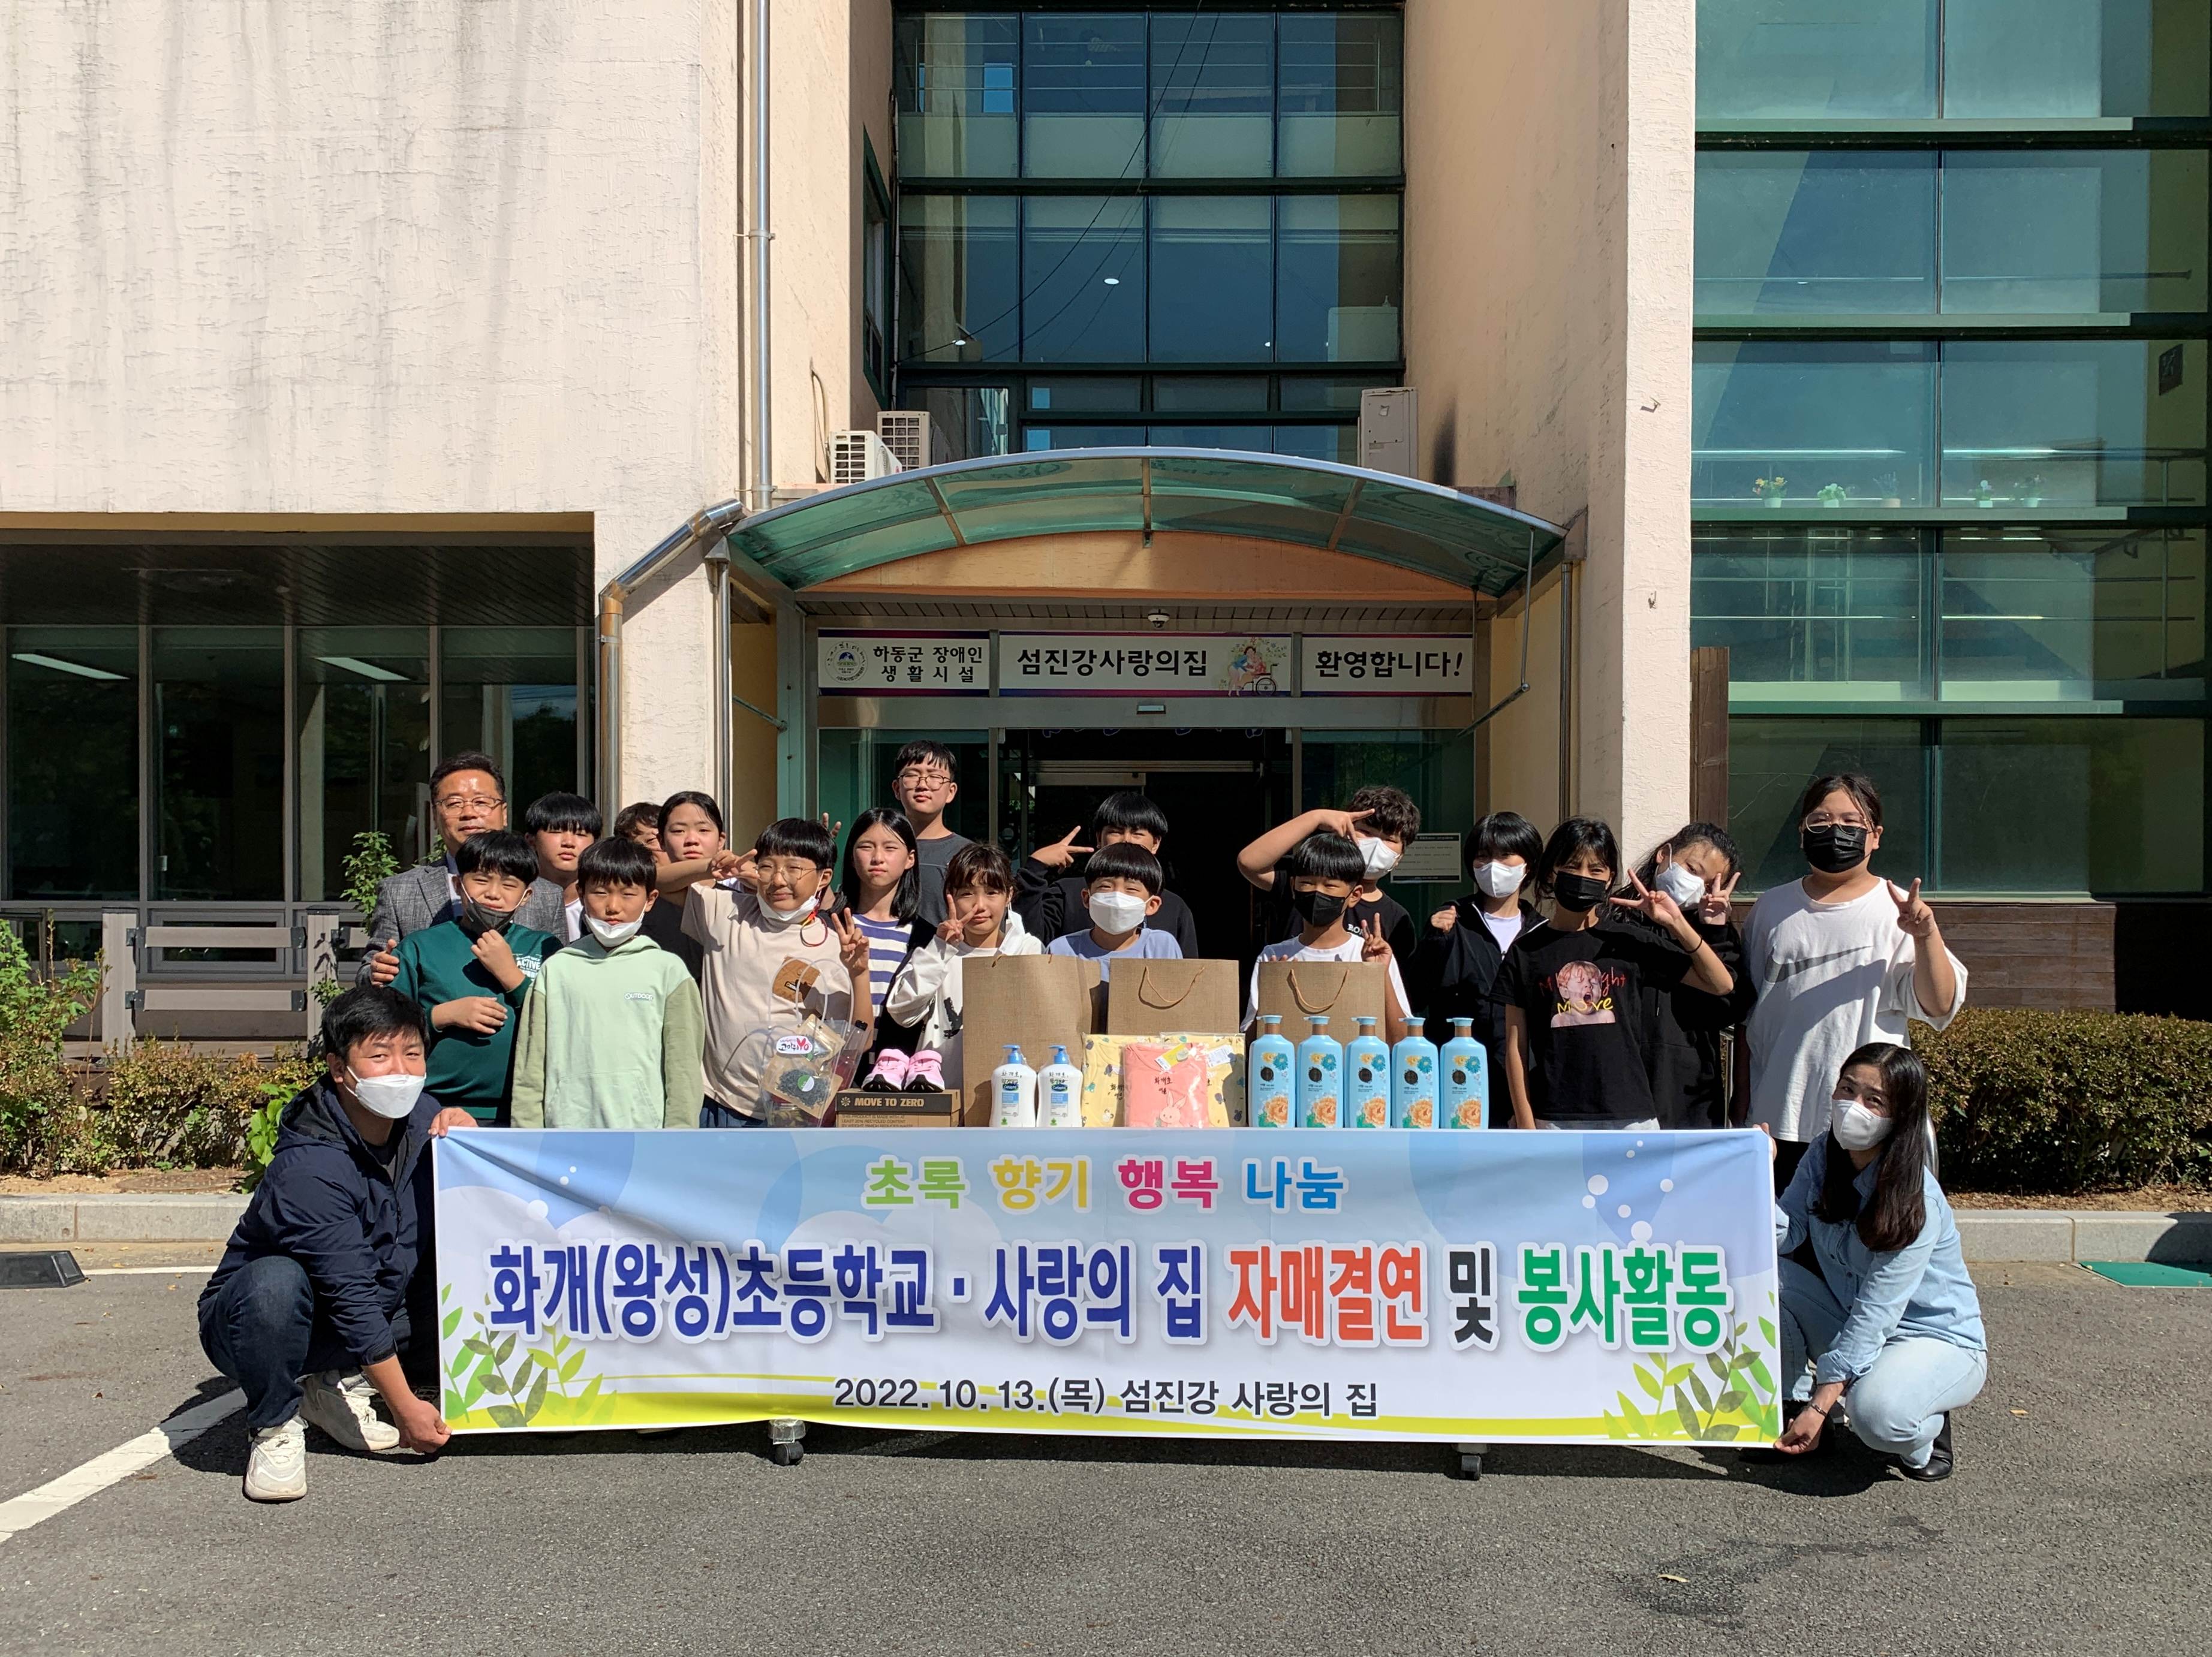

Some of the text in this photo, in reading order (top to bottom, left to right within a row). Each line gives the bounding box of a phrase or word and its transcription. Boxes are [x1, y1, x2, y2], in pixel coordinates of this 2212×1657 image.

[873, 646, 923, 663] 하동군
[932, 646, 982, 664] 장애인
[1017, 649, 1206, 677] 섬진강사랑의집
[1315, 650, 1463, 679] 환영합니다!
[854, 1098, 925, 1107] MOVE TO ZERO
[866, 1159, 1344, 1210] 초록 향기 행복 나눔
[985, 1246, 1130, 1340] 사랑의
[1157, 1246, 1200, 1338] 집
[1228, 1246, 1422, 1340] 자매결연
[1449, 1248, 1495, 1343] 및
[1518, 1248, 1726, 1346] 봉사활동
[835, 1377, 1377, 1417] 2022. 10. 13.(목) 섬진강 사랑의 집
